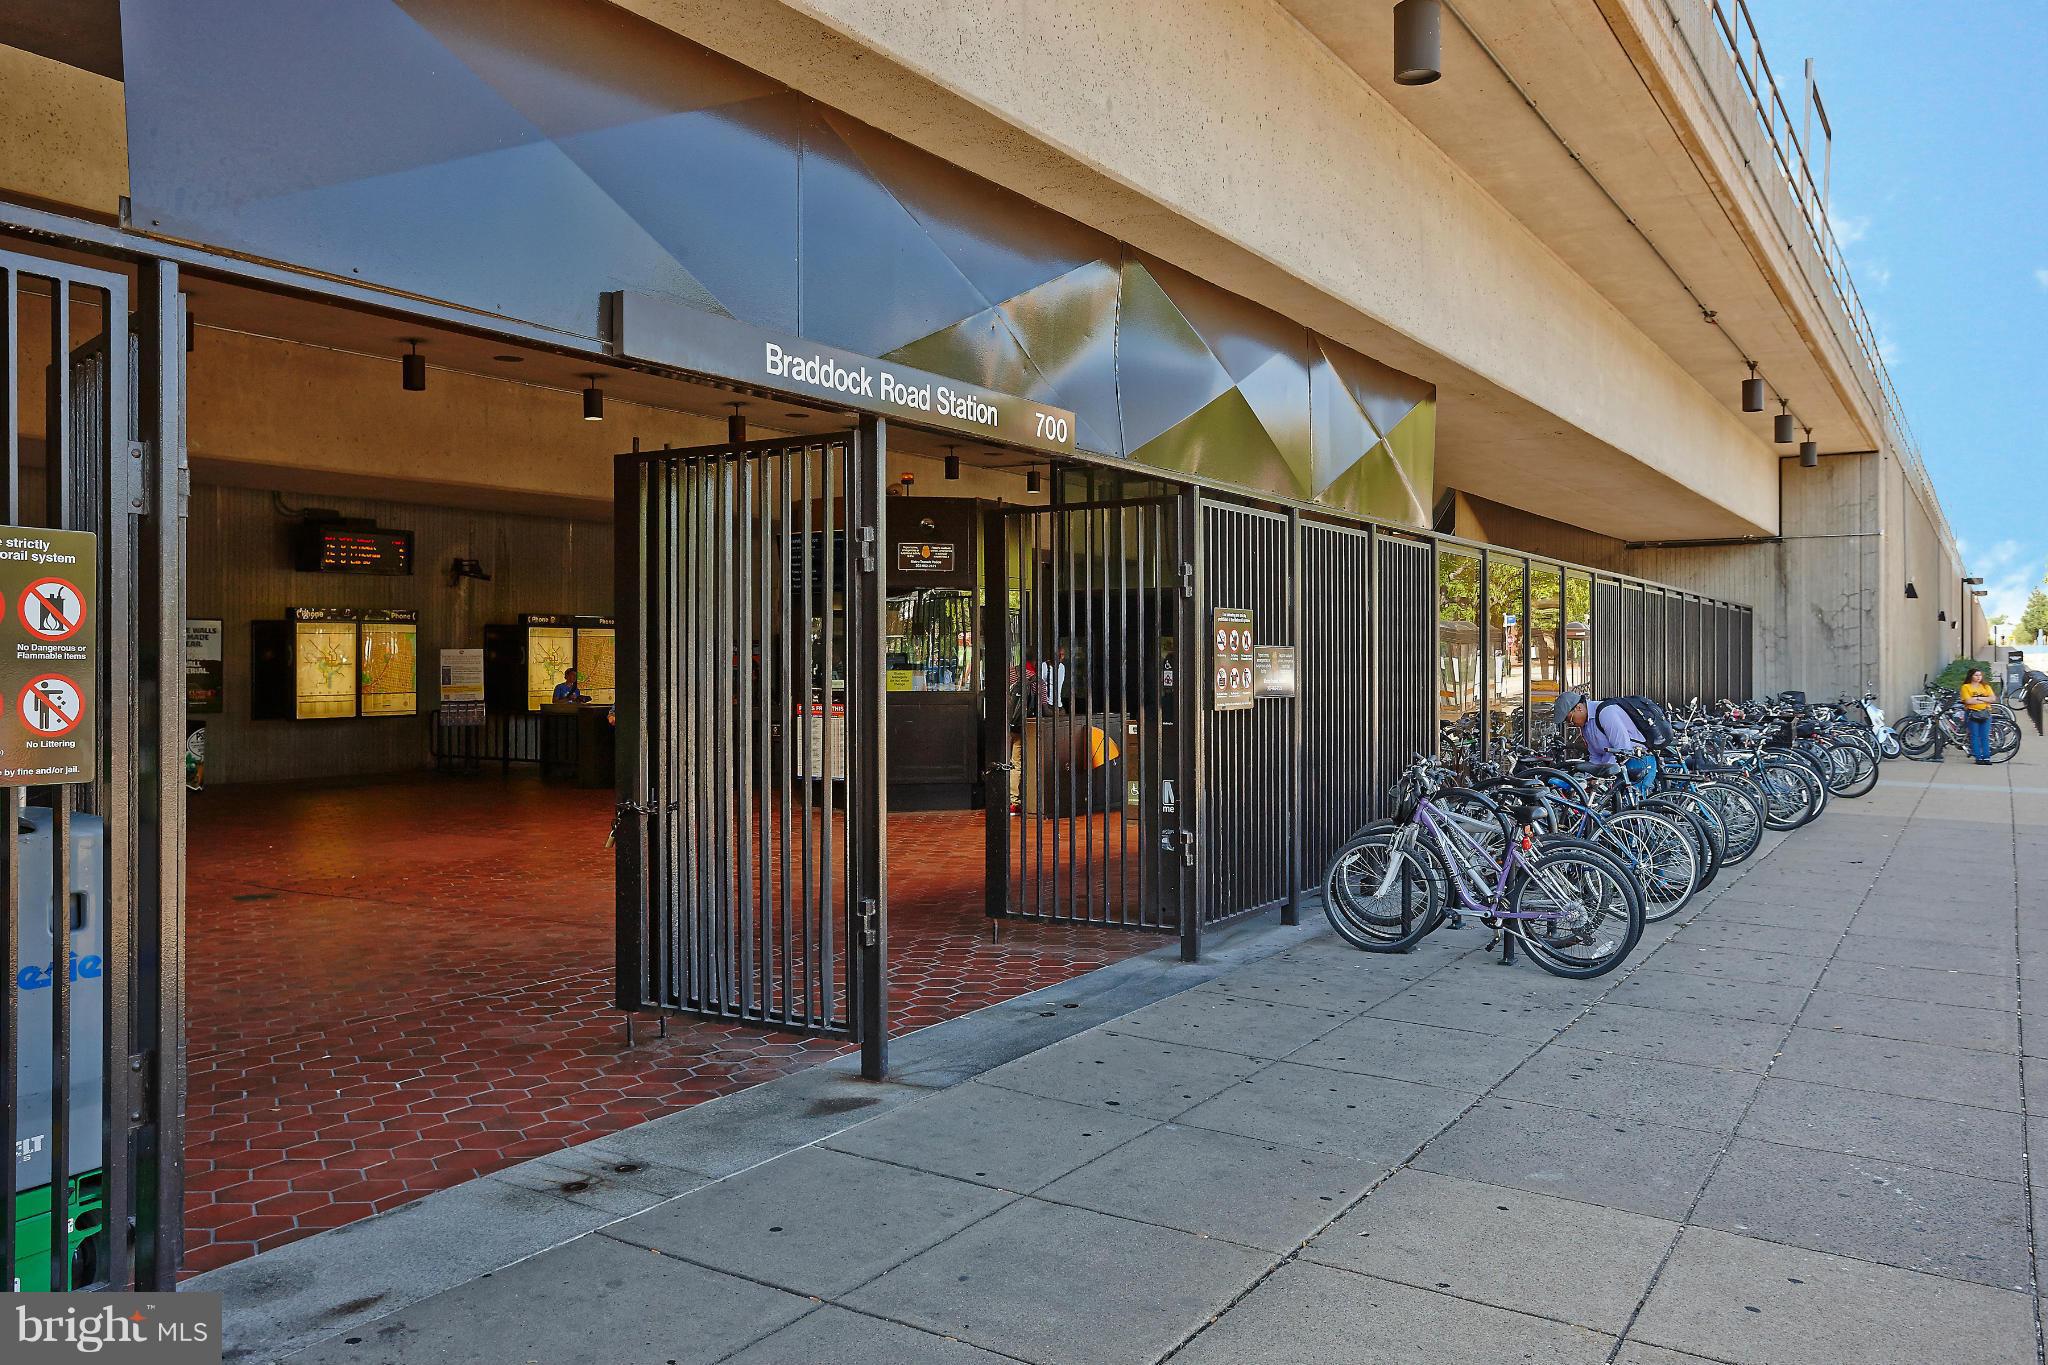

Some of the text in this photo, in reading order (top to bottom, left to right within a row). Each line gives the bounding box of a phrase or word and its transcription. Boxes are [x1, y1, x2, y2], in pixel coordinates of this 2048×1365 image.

[766, 342, 1068, 443] Braddock Road Station 700
[6, 538, 50, 552] strictly
[31, 552, 76, 564] system
[17, 643, 30, 651] No
[31, 643, 76, 652] Dangerous
[17, 651, 87, 660] Flammable Items
[40, 740, 76, 749] Littering
[4, 769, 15, 777] by
[35, 766, 63, 775] and/or
[65, 765, 80, 774] jail.
